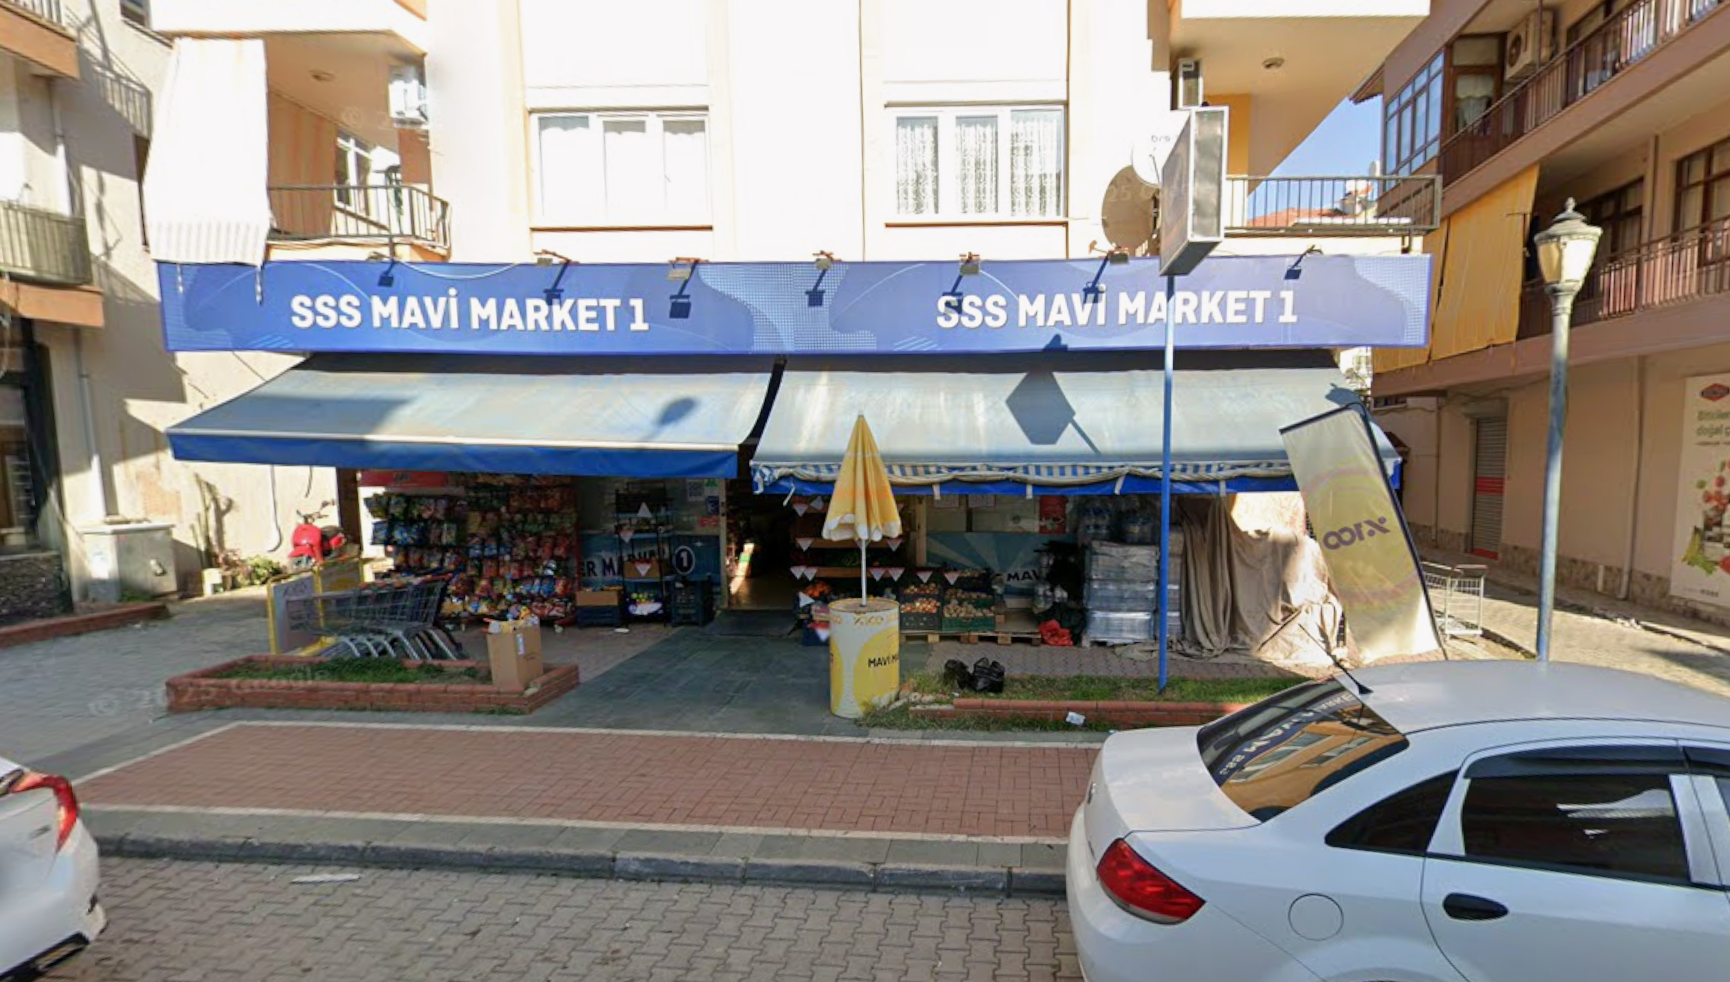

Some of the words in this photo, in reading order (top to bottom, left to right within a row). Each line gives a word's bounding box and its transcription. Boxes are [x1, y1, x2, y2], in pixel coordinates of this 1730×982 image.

[291, 294, 362, 330] SSS
[370, 288, 459, 330] MAVİ
[469, 296, 621, 332] MARKET
[629, 298, 650, 331] 1
[936, 293, 1007, 329] SSS
[1017, 284, 1106, 328] MAVİ
[1117, 290, 1270, 326] MARKET
[1278, 290, 1298, 323] 1
